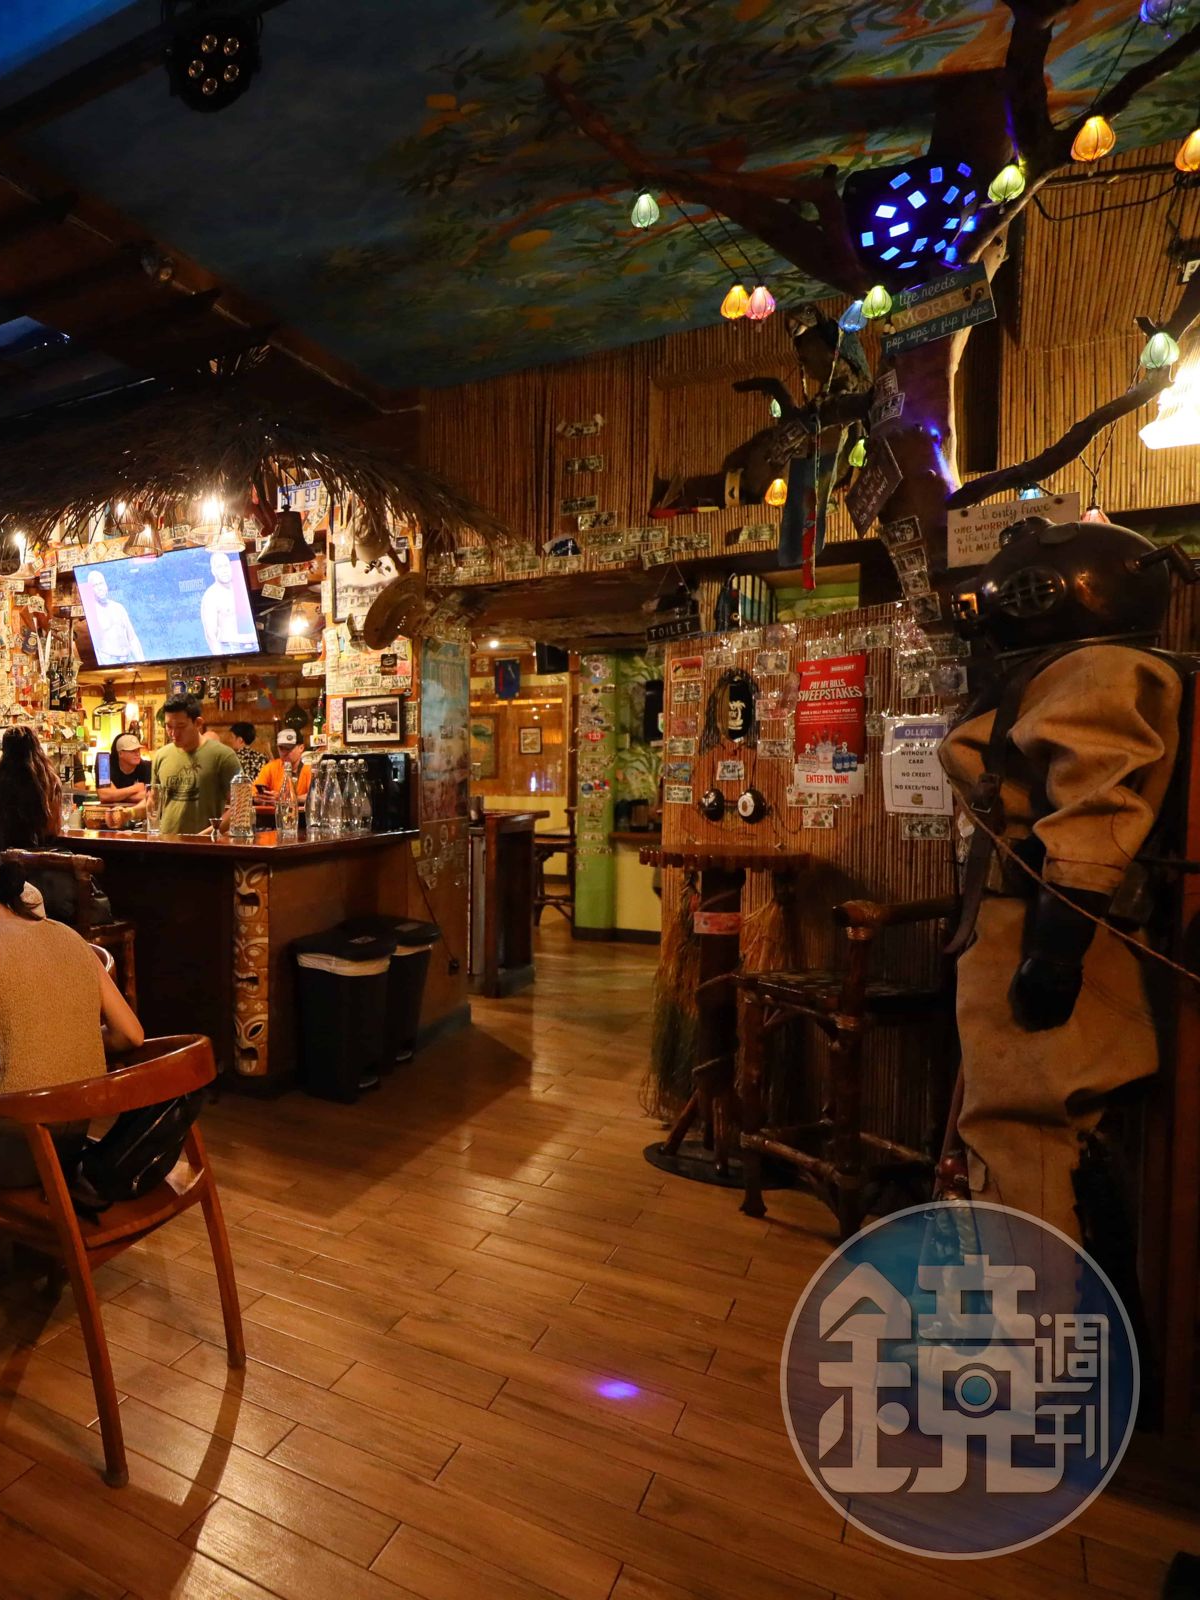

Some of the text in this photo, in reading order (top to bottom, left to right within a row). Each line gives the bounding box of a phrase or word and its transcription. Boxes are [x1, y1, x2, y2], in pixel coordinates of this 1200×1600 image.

[921, 276, 956, 297] needs
[896, 295, 961, 327] MORE
[991, 505, 1017, 521] only
[1021, 501, 1051, 515] have
[649, 621, 691, 640] TOILET
[798, 686, 862, 701] SWEEPSTAKES
[809, 678, 846, 690] PAY MY BILLS
[806, 774, 849, 784] ENTER TO WIN!
